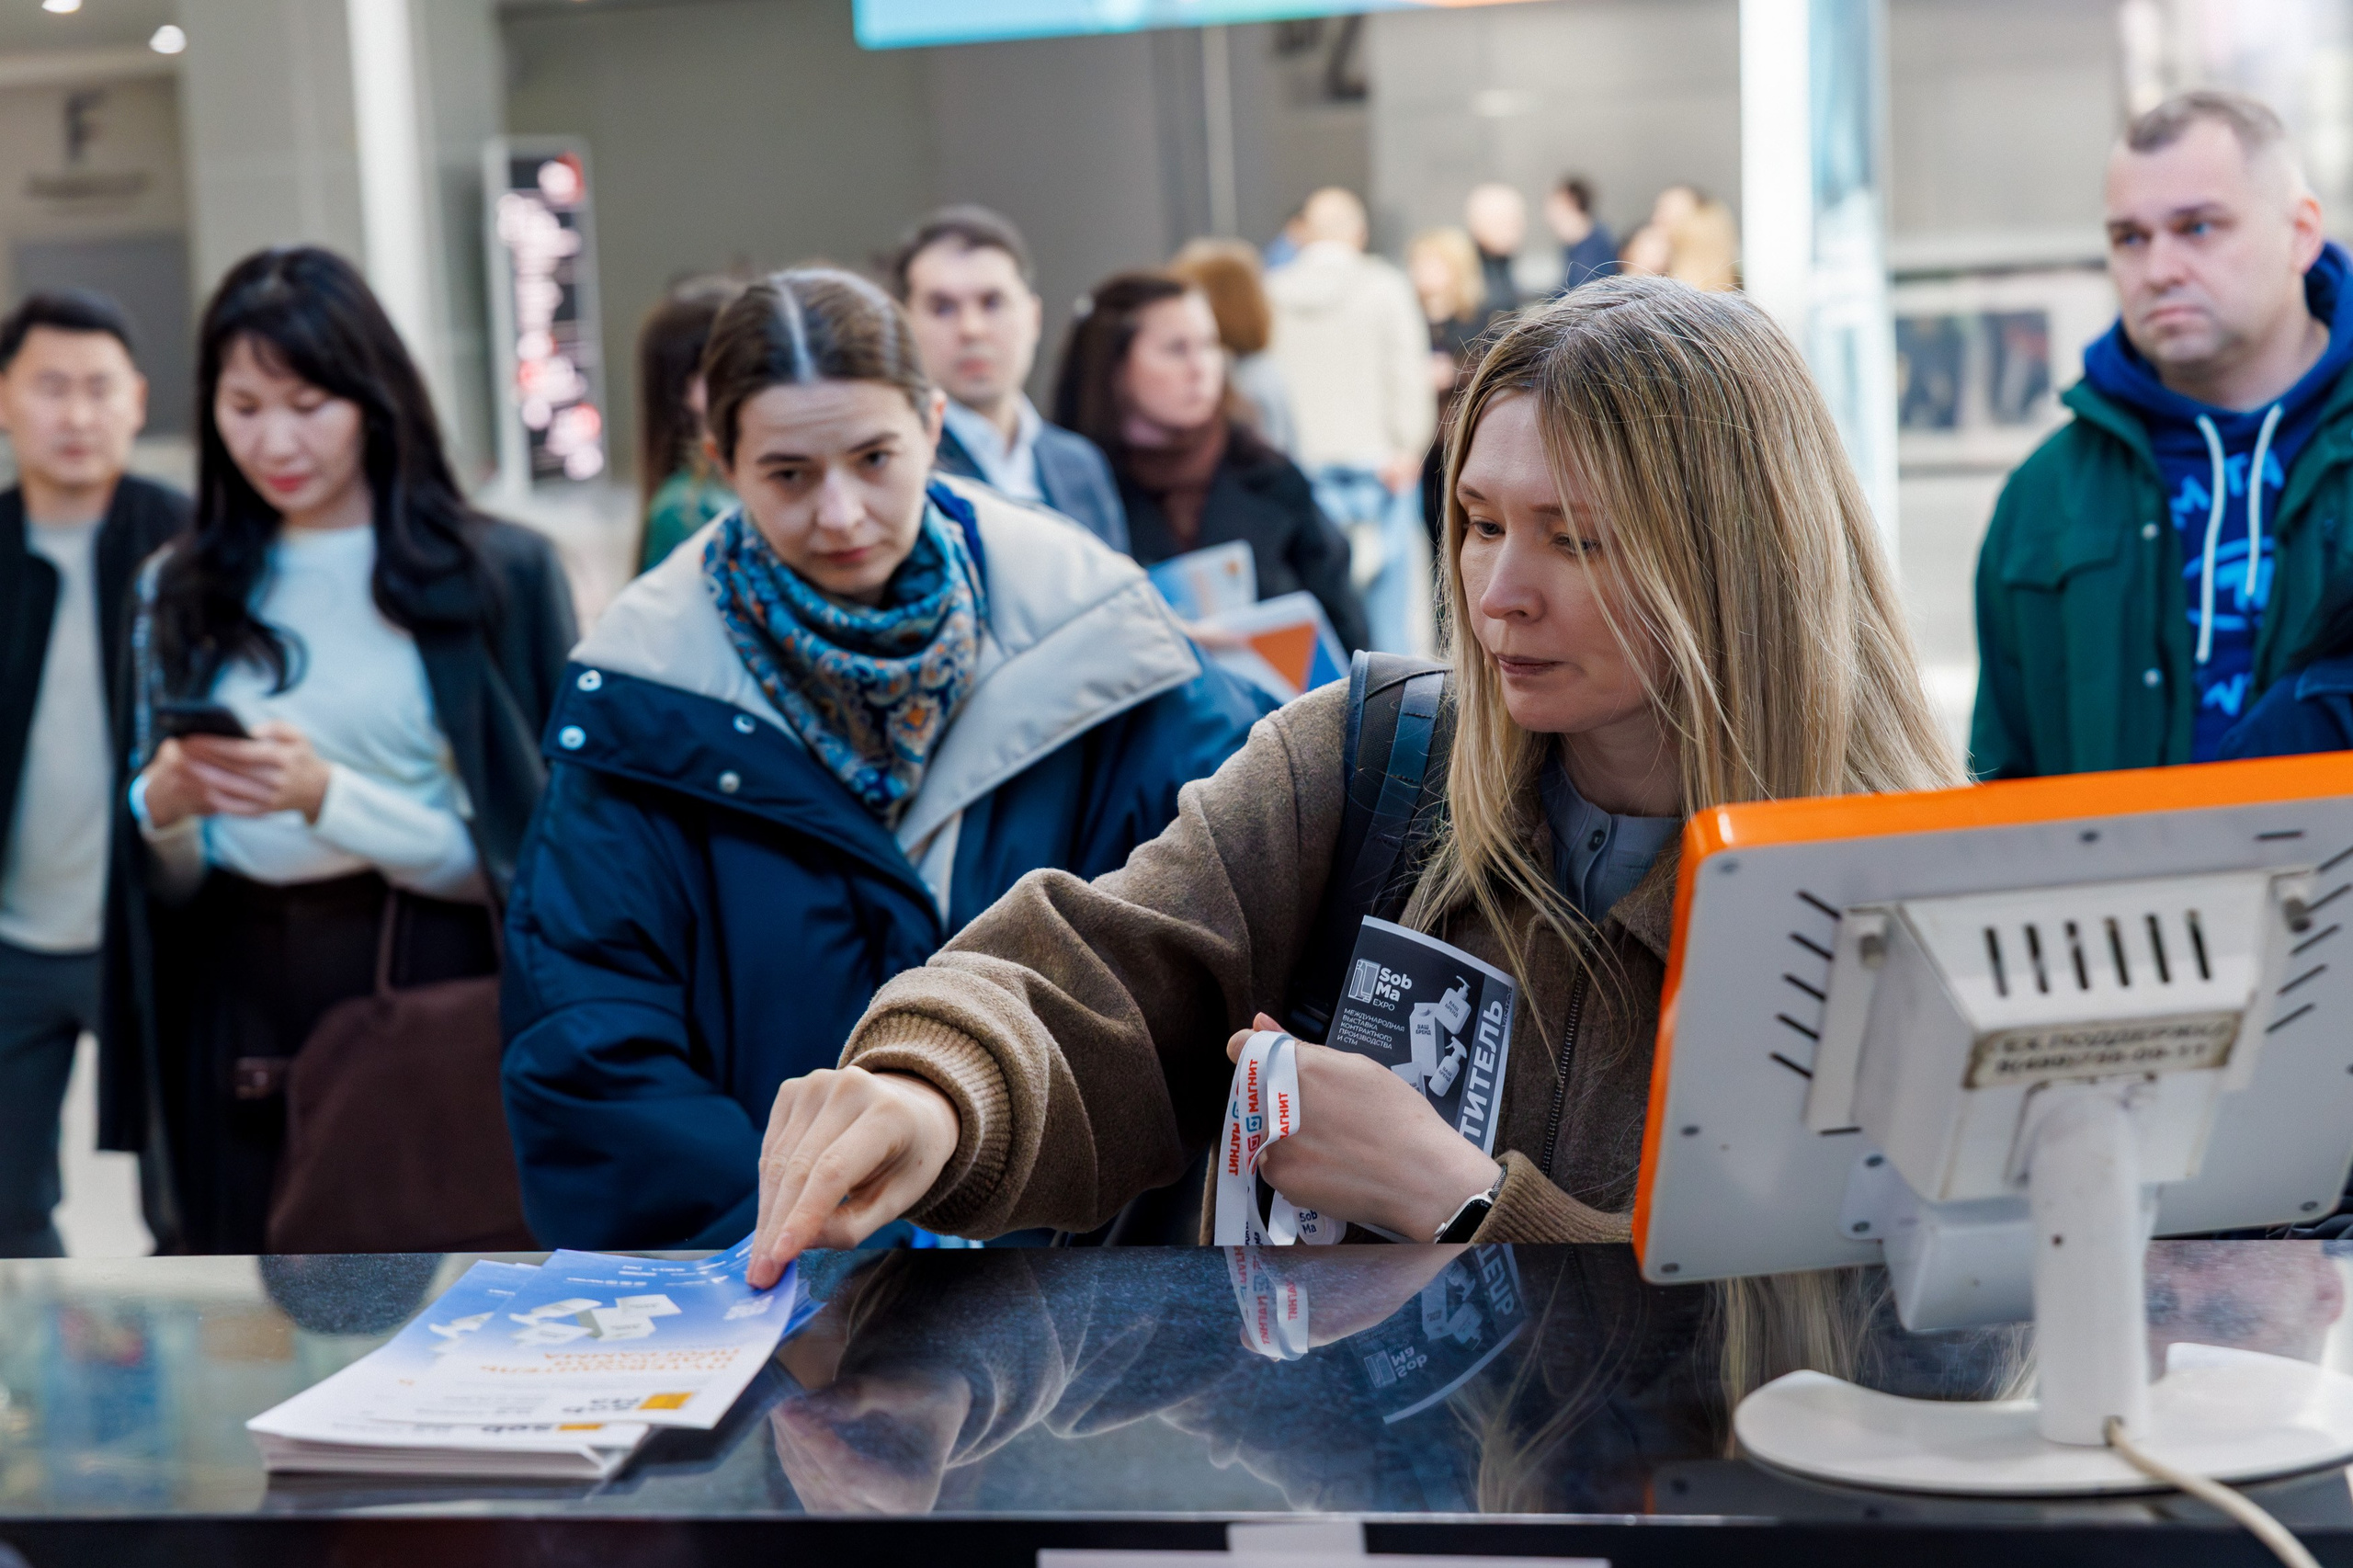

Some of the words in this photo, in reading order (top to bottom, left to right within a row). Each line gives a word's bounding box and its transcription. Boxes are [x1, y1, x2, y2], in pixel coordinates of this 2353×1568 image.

[1379, 967, 1413, 990] Sob
[1375, 981, 1401, 1002] Ma
[1372, 998, 1395, 1011] EXPO
[1342, 1014, 1378, 1030] ВЫСТАВКА
[1344, 1007, 1405, 1032] МЕЖДУНАРОДНАЯ
[1338, 1028, 1392, 1050] ПРОИЗВОДСТВА
[1340, 1021, 1392, 1042] КОНТРАКТНОГО
[1344, 1037, 1358, 1046] СТМ
[1247, 1059, 1258, 1113] МАГНИТ
[1299, 1210, 1318, 1222] Sob
[1302, 1223, 1317, 1234] Ma
